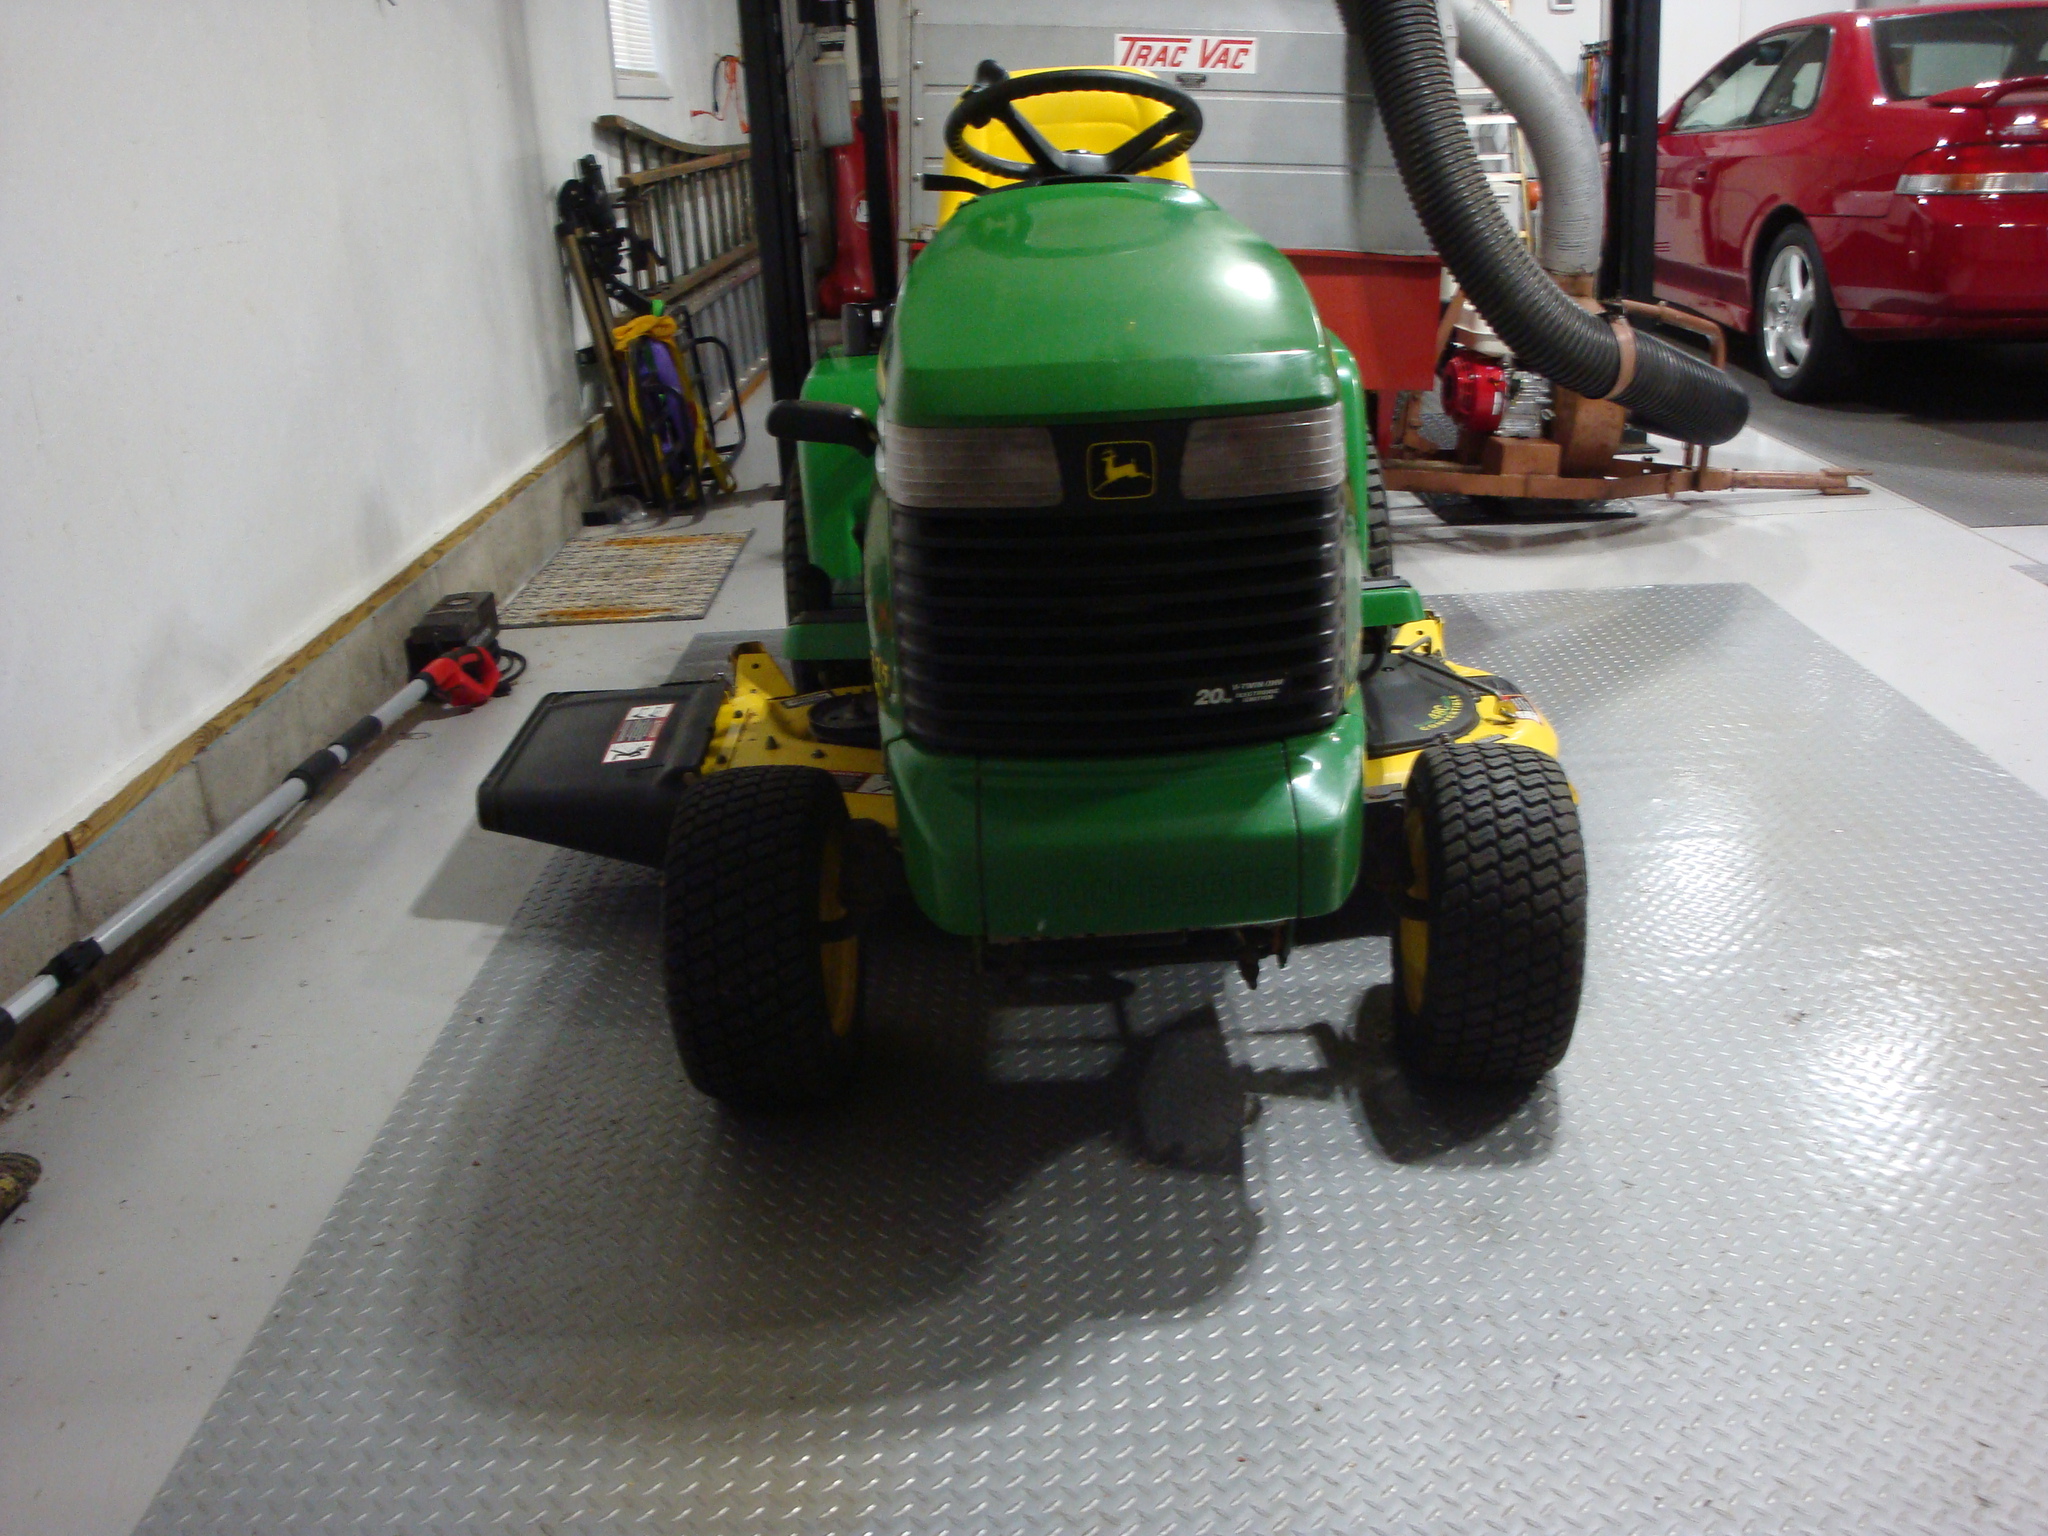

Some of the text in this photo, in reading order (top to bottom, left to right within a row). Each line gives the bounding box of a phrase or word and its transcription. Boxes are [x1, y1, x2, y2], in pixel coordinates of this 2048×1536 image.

[1119, 36, 1254, 69] TRAC VAC
[1194, 688, 1225, 705] 20
